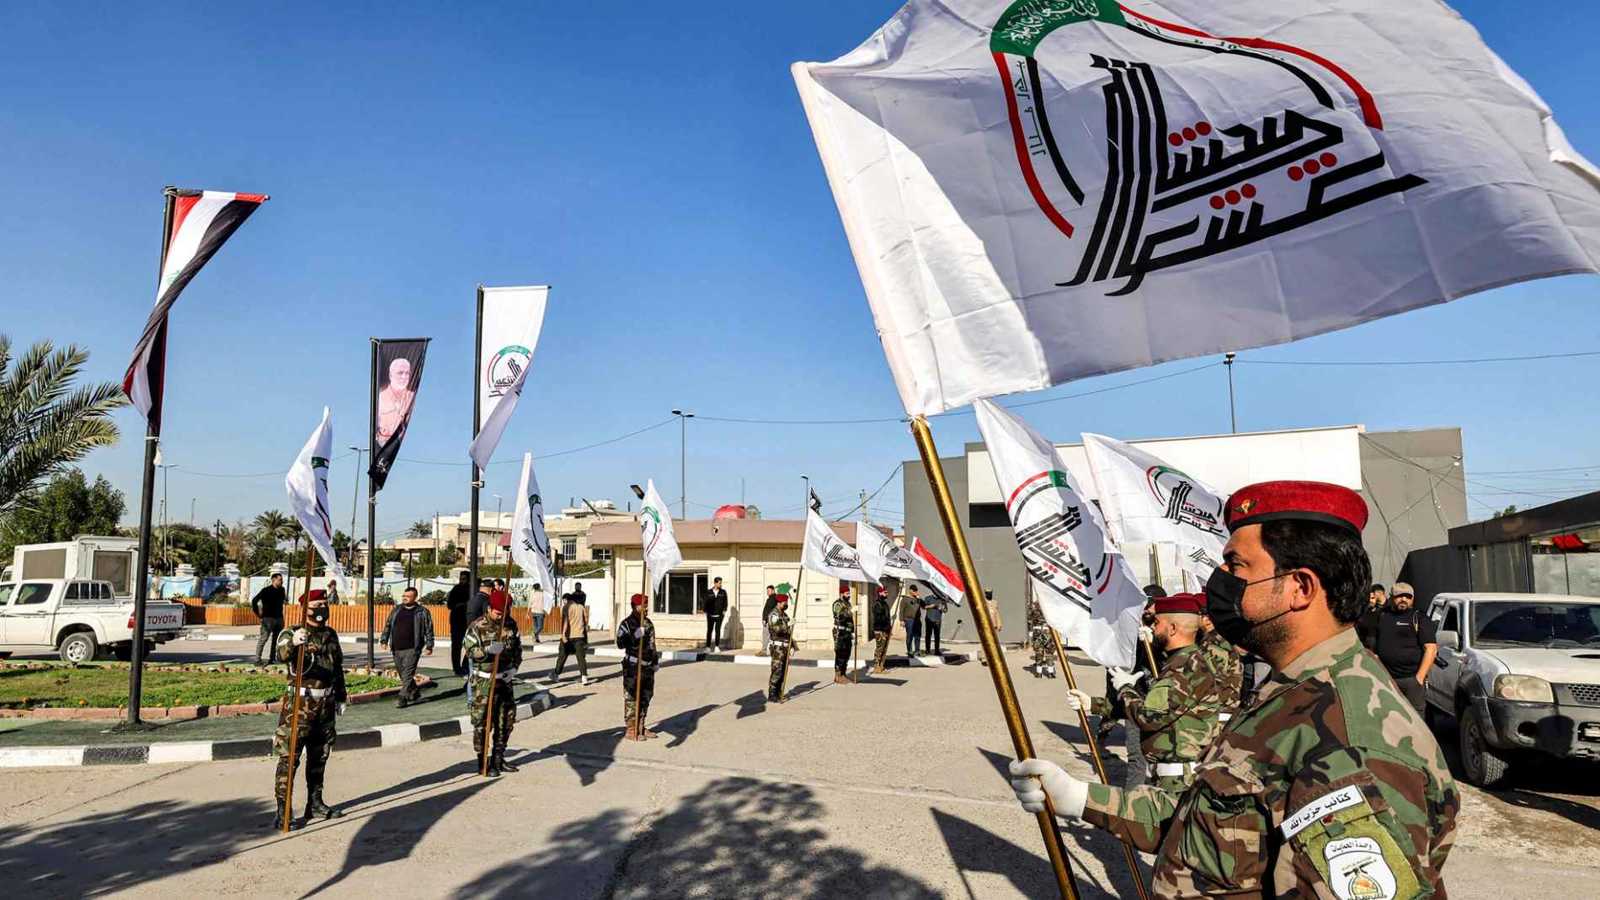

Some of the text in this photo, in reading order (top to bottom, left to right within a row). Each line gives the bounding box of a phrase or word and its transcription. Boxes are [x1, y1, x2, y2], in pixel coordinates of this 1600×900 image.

[147, 614, 177, 625] TOYOTA
[1290, 792, 1351, 830] كتائب حزب الله
